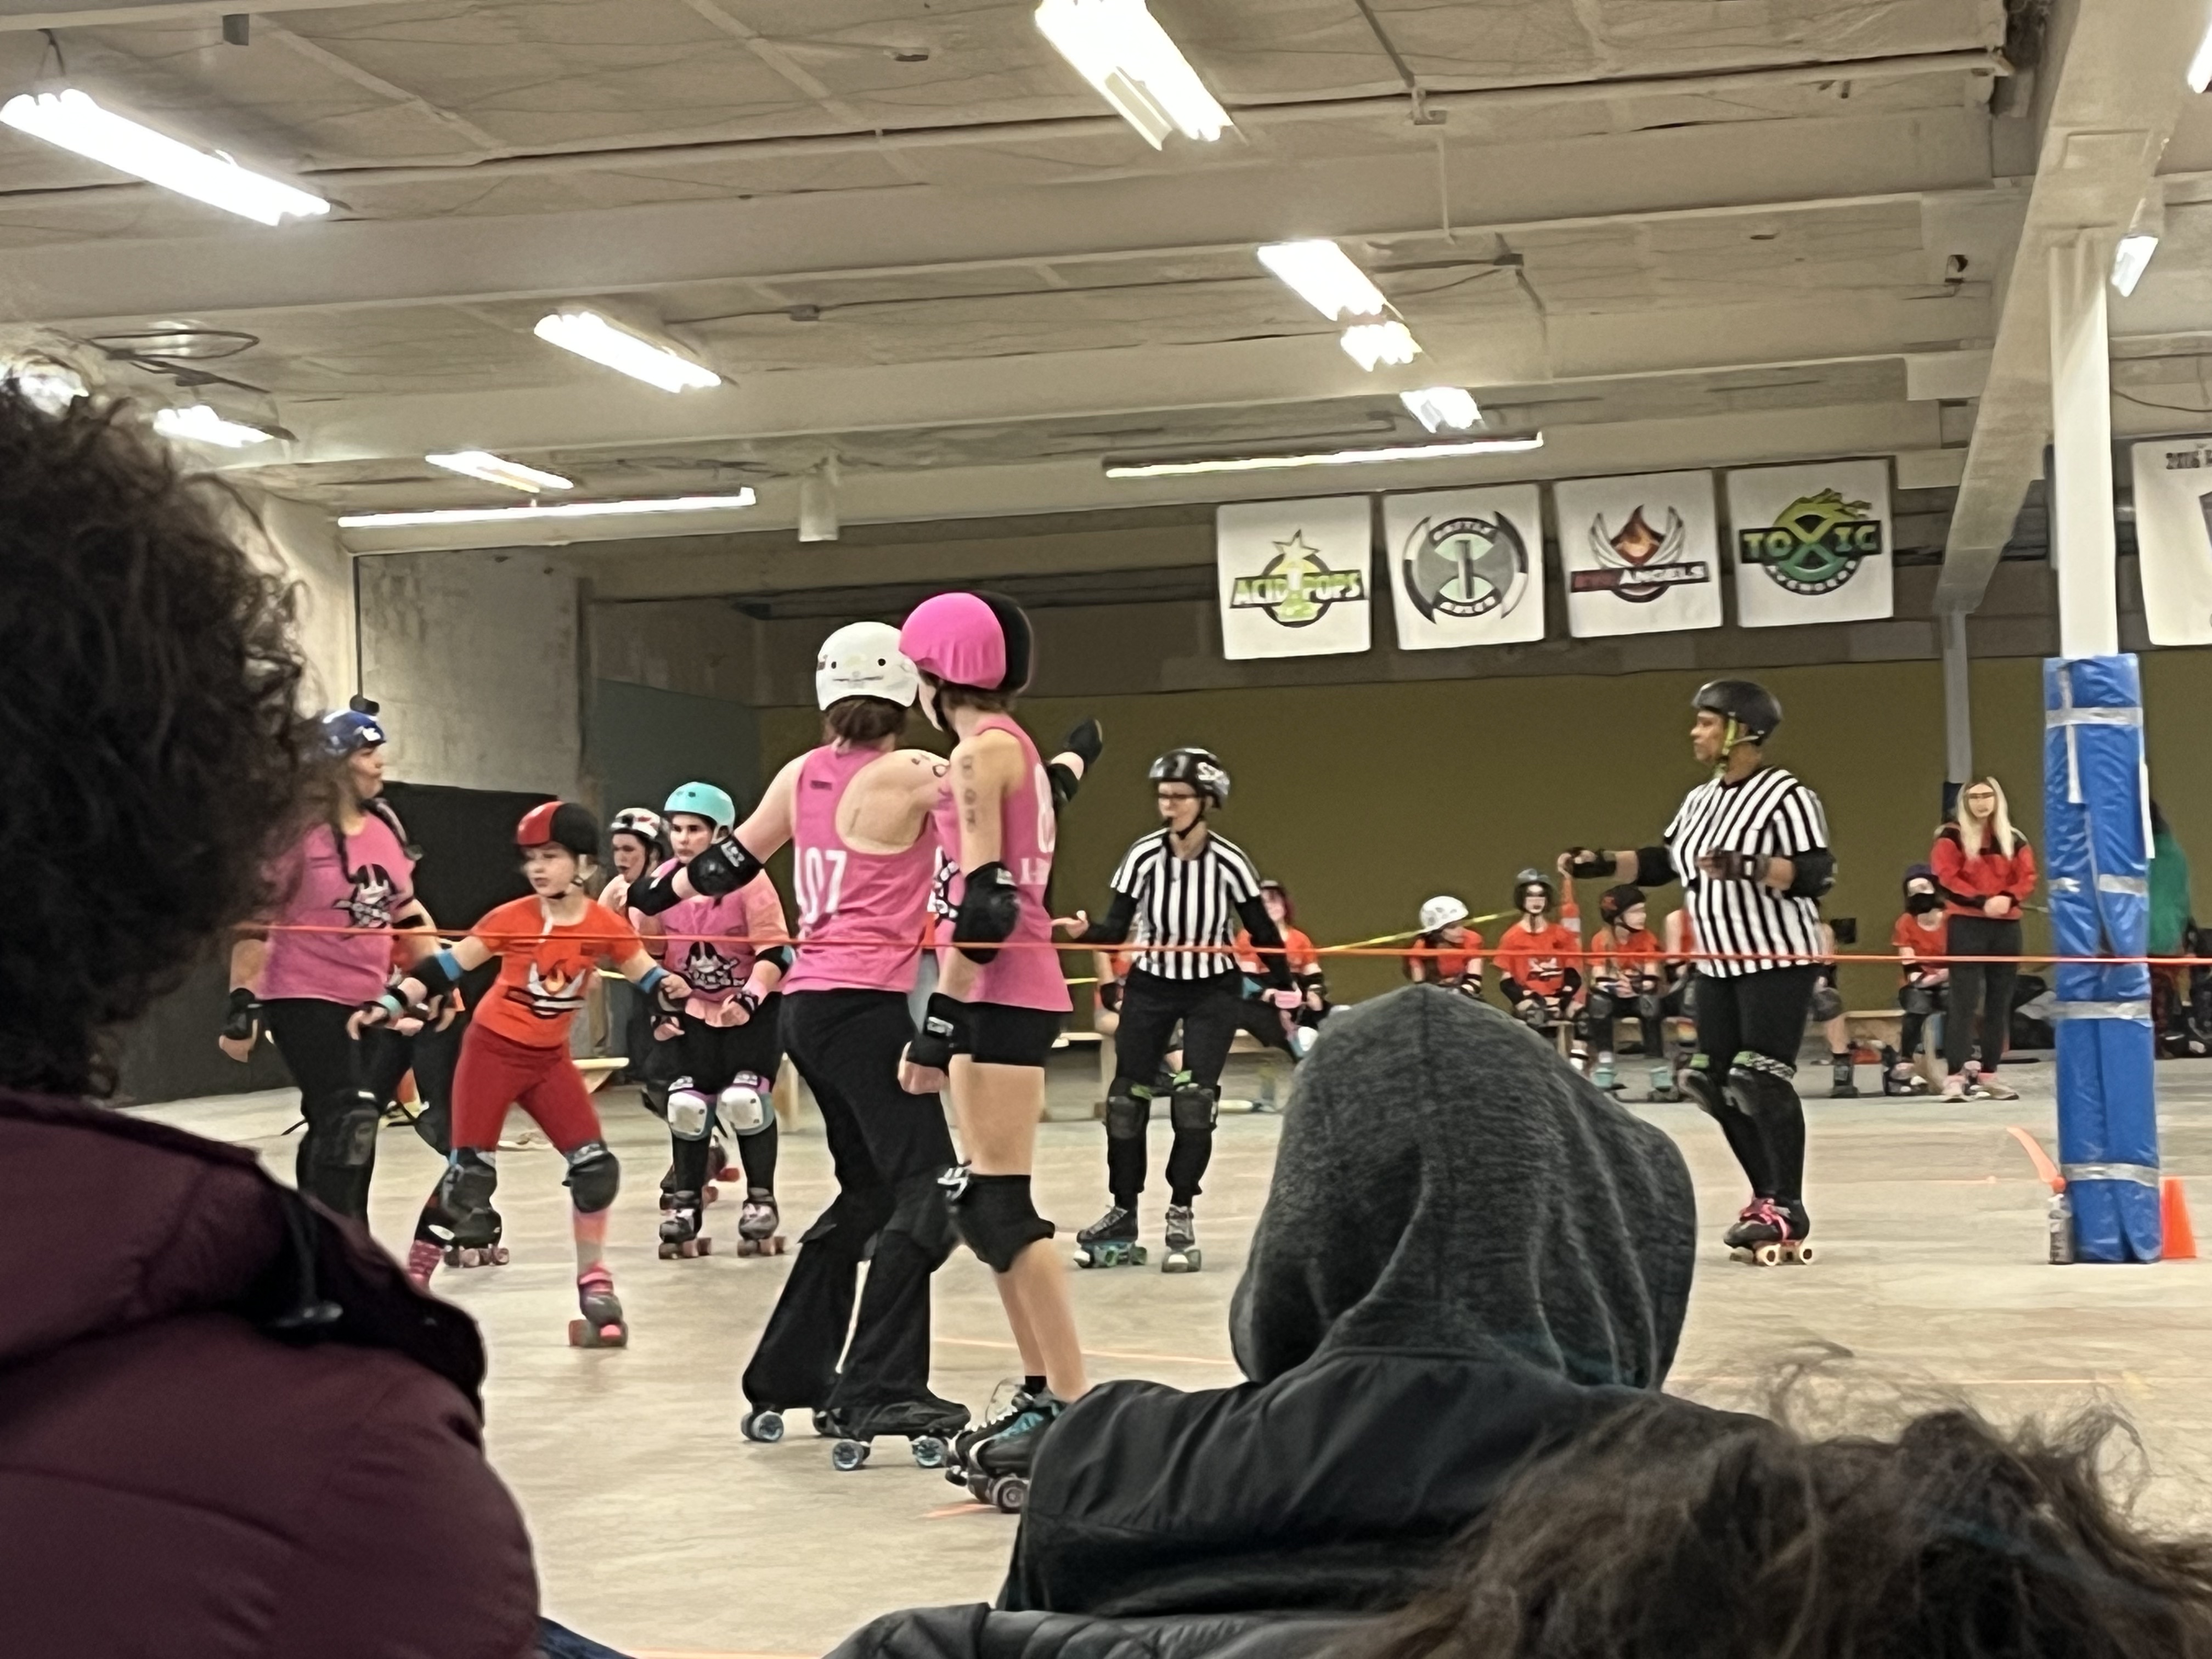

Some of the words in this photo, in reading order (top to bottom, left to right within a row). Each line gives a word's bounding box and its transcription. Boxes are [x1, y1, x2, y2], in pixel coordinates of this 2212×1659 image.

[1742, 518, 1878, 565] TOXIC
[1233, 578, 1288, 605] ACID
[1302, 572, 1362, 601] POPS
